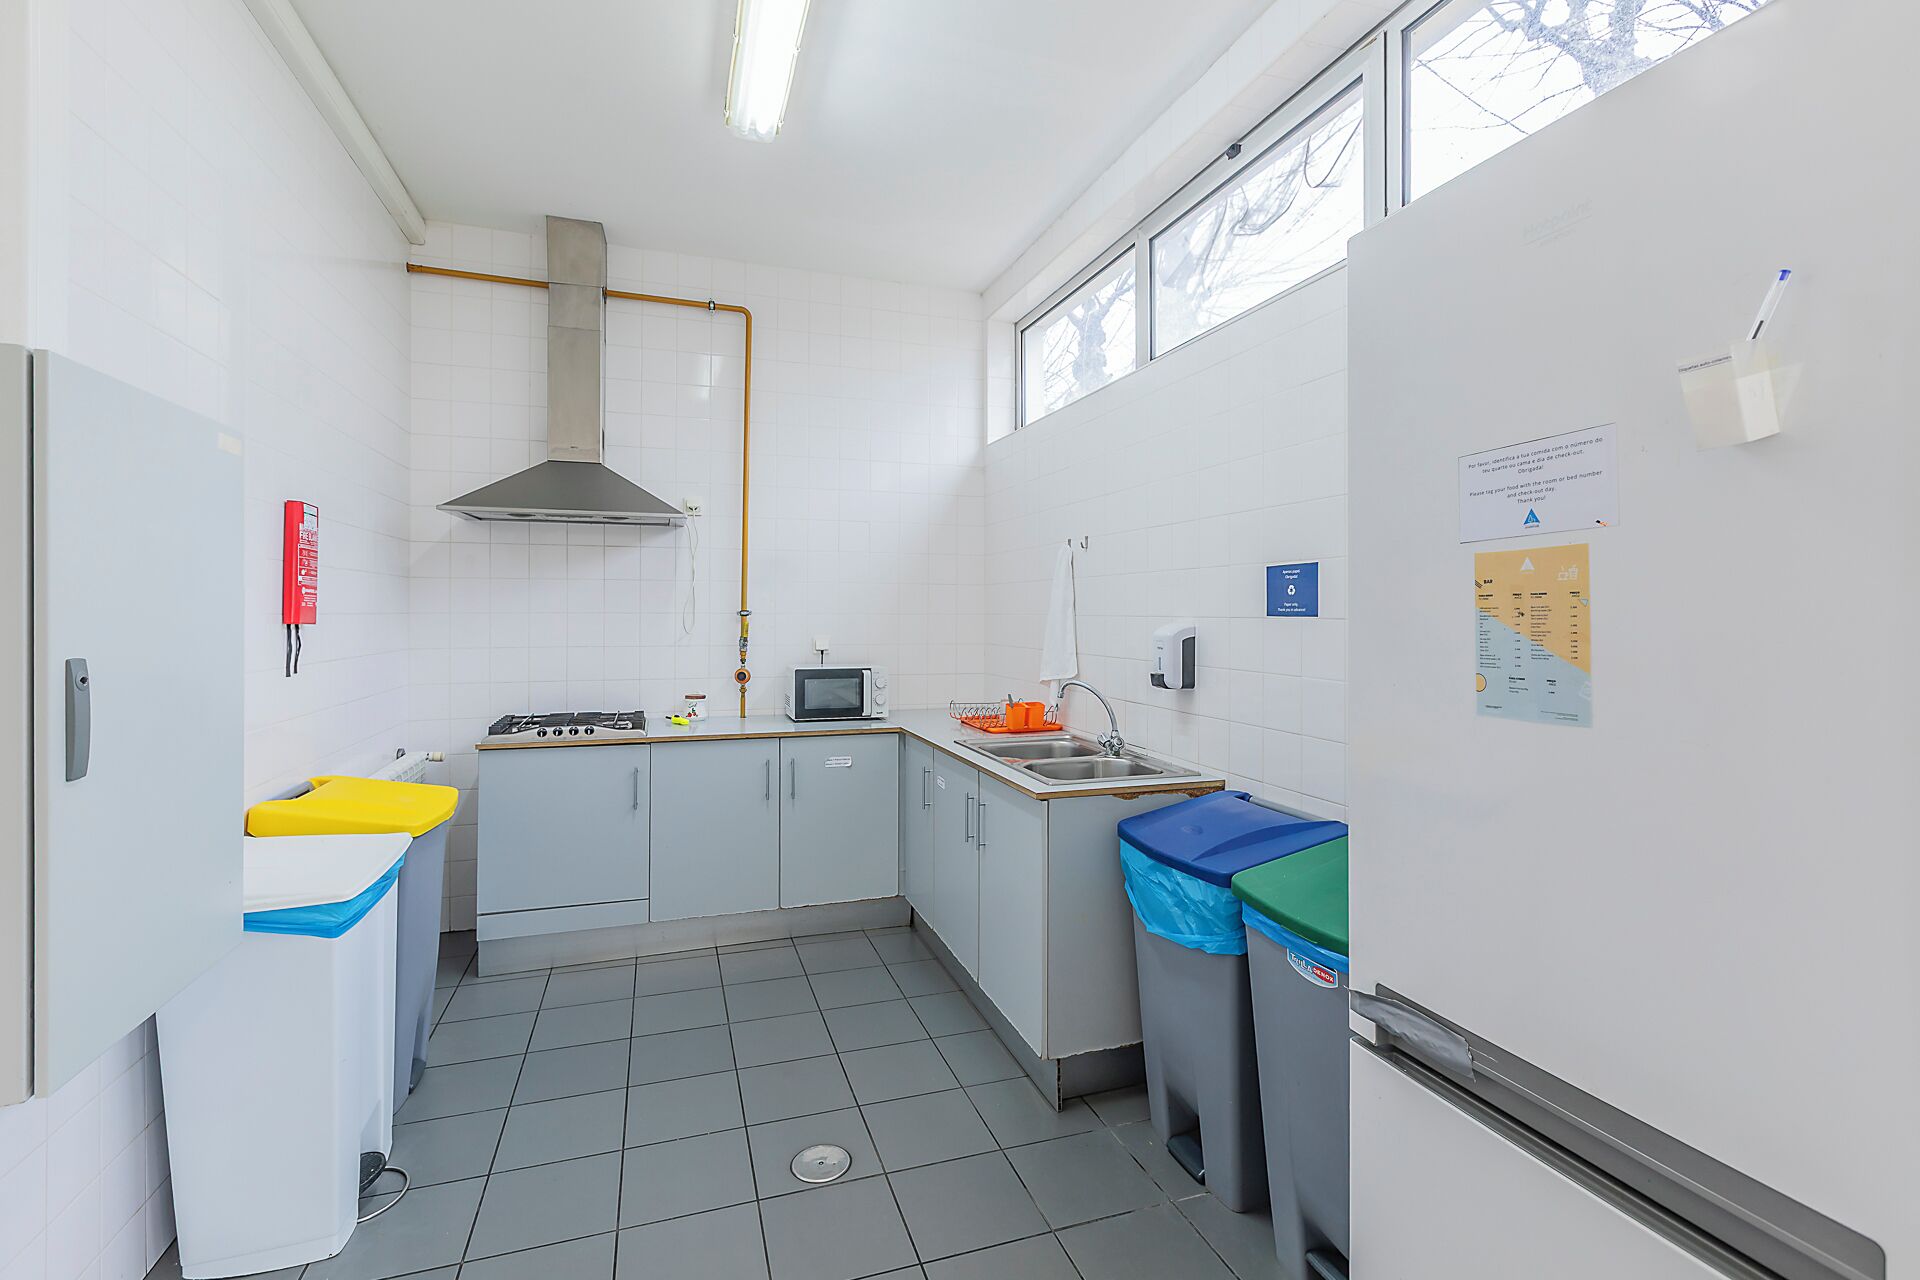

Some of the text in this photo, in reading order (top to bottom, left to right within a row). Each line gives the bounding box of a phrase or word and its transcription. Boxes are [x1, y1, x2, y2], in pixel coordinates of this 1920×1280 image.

[1492, 456, 1515, 464] identifica
[1531, 448, 1550, 456] comida
[1491, 464, 1508, 472] quarto
[1579, 470, 1602, 478] number
